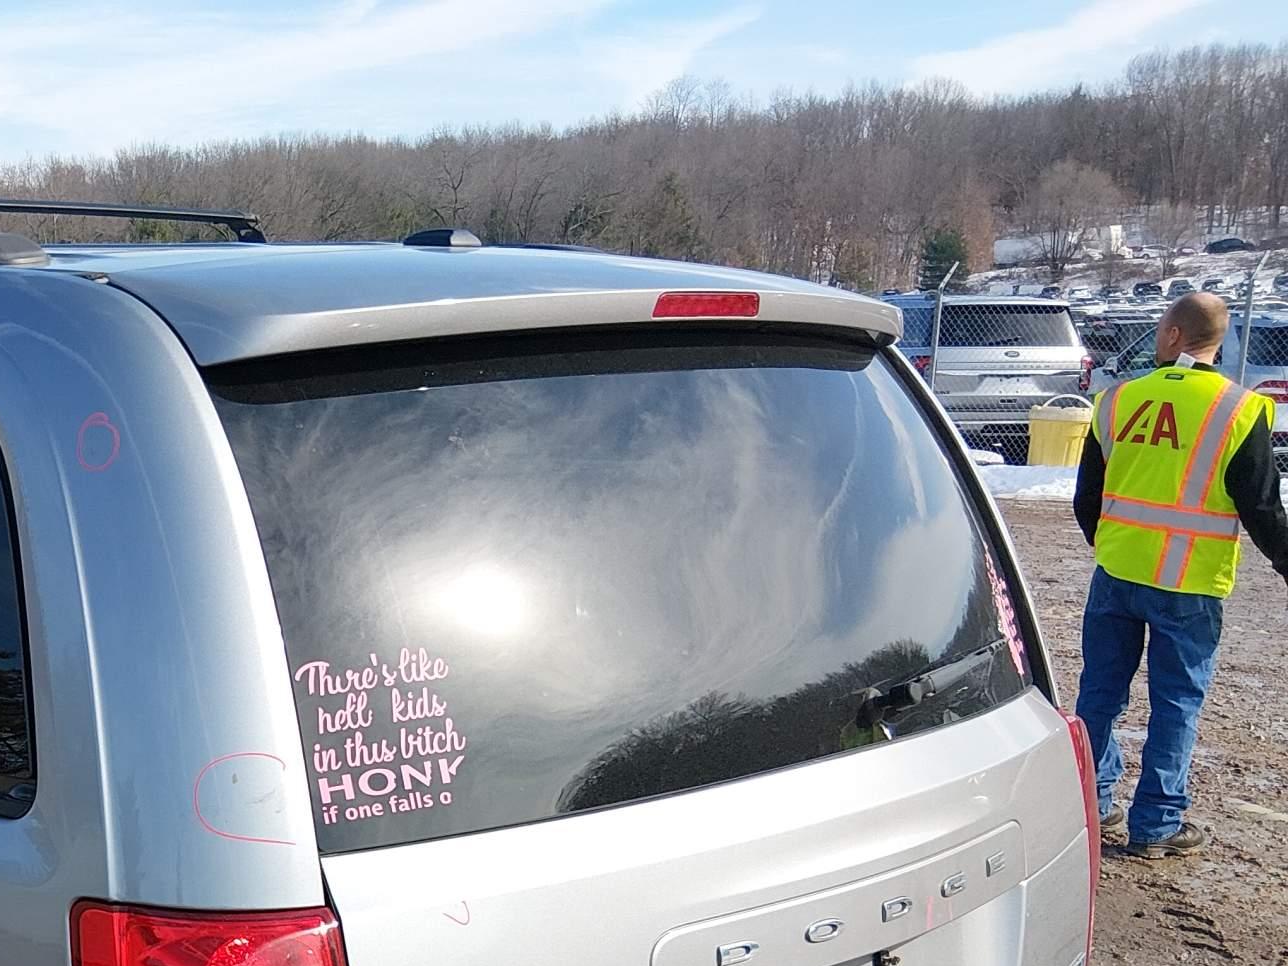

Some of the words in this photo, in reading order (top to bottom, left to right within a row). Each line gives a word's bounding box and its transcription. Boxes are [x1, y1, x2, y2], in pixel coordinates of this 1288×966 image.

[398, 647, 449, 683] like
[318, 692, 373, 734] hell
[391, 687, 447, 722] kids
[313, 743, 342, 773] in
[344, 732, 397, 768] this
[399, 718, 466, 758] bitch
[322, 805, 338, 825] if
[345, 802, 385, 821] one
[388, 791, 434, 814] falls
[716, 850, 1006, 966] DODGE
